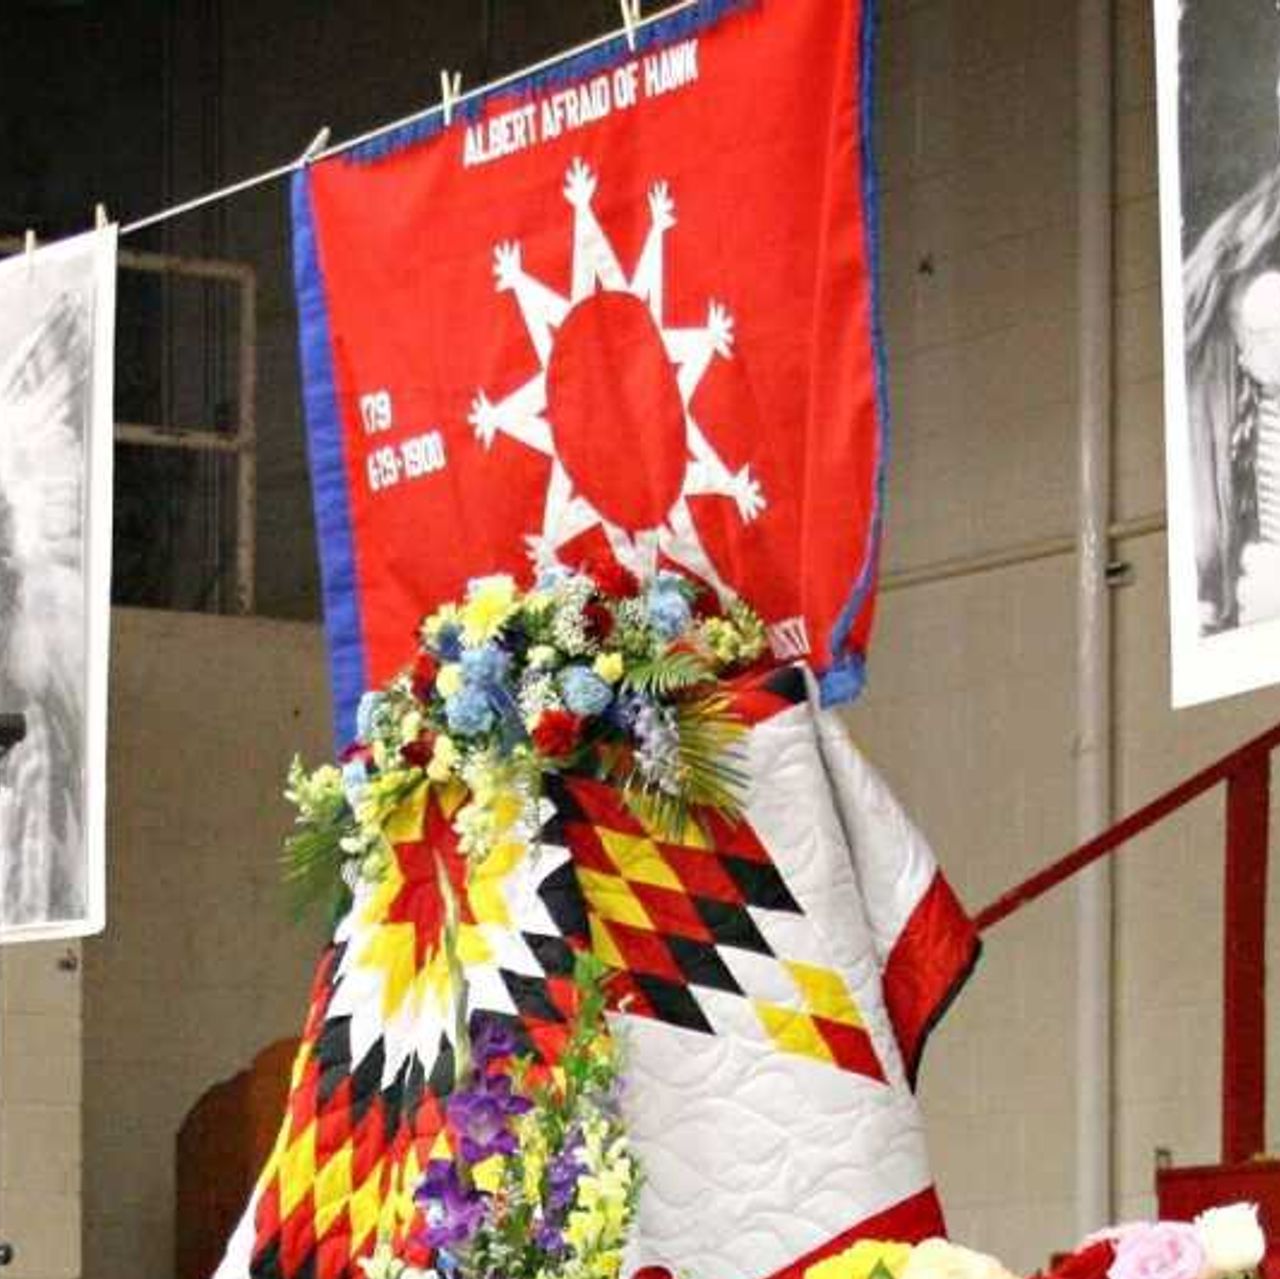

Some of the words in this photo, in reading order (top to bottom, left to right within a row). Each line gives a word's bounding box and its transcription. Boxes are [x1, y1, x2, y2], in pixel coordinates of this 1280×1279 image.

[462, 102, 537, 169] ALBERT
[541, 75, 611, 142] AFRAID
[613, 61, 639, 110] OF
[643, 38, 699, 98] HAWK
